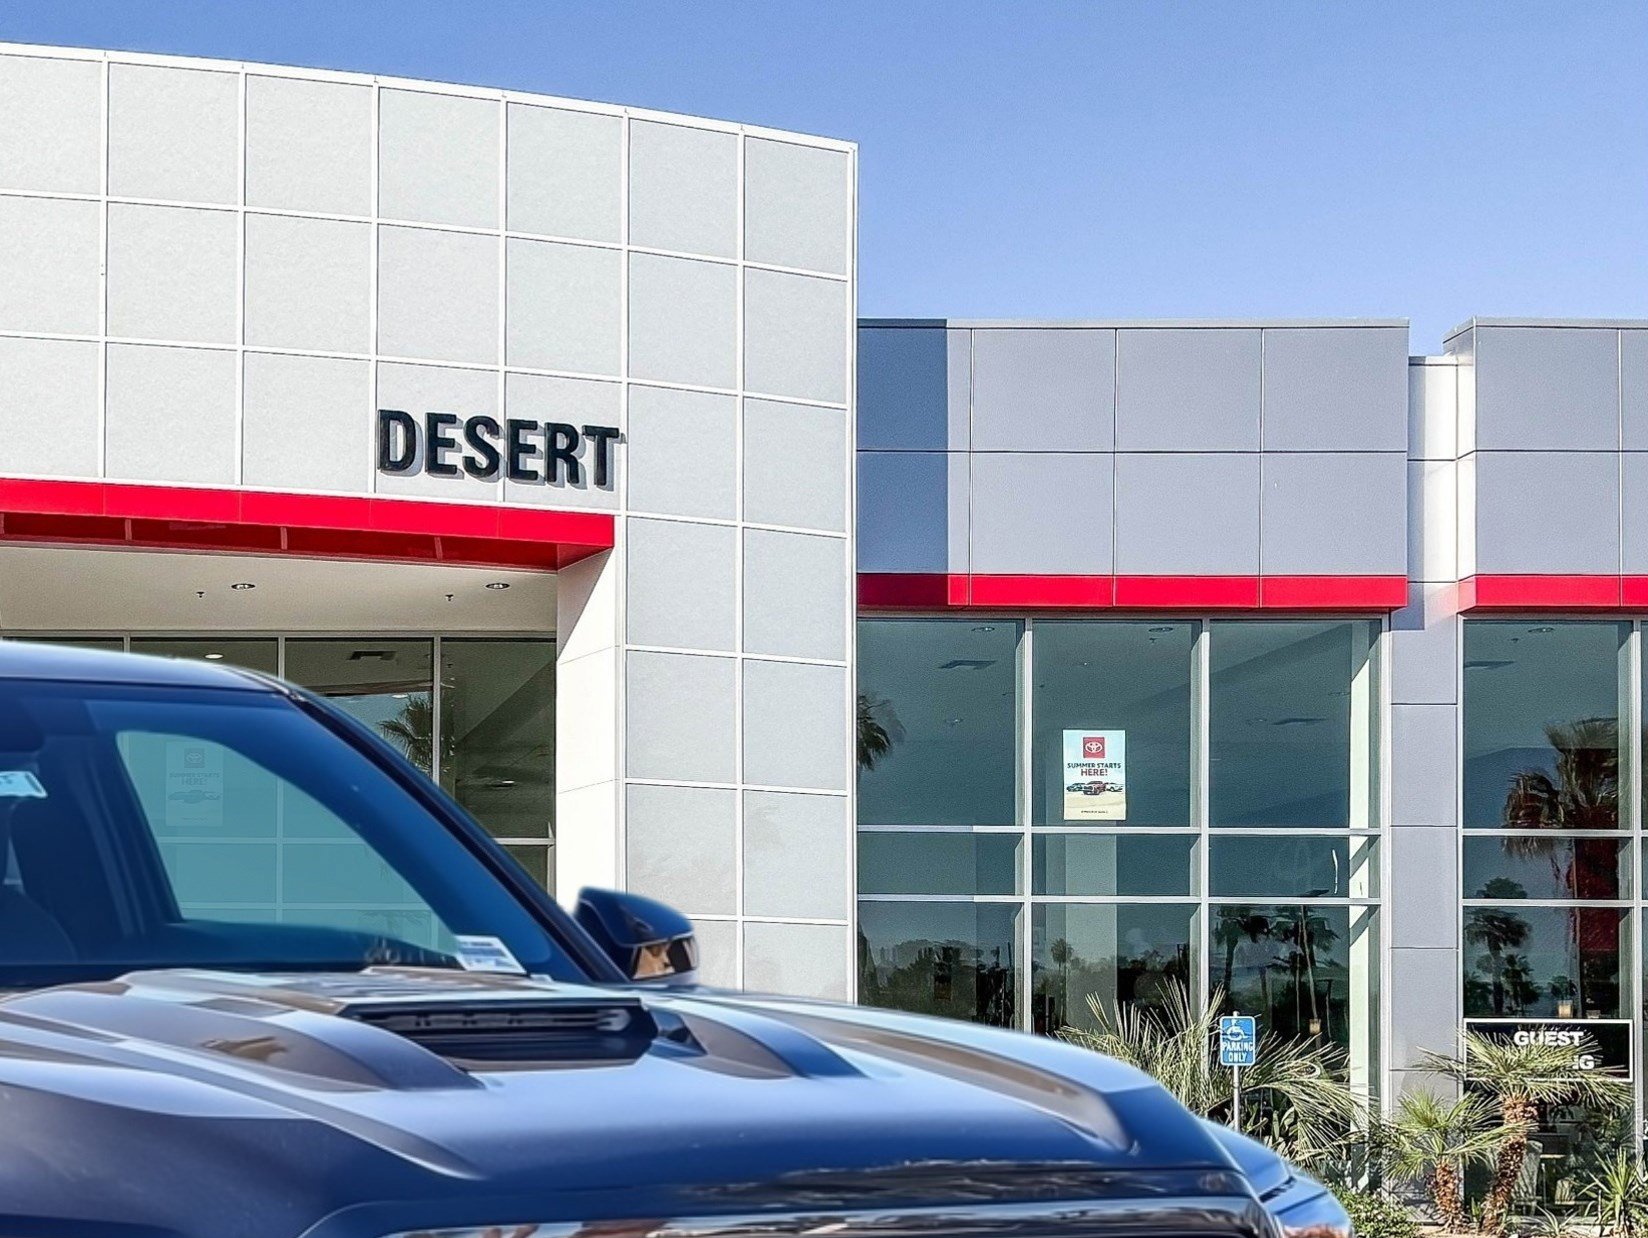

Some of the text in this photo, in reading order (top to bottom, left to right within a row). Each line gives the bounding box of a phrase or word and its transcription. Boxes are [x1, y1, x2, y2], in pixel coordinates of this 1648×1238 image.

[378, 409, 620, 486] DESERT
[1514, 1030, 1584, 1046] GUEST
[1222, 1041, 1253, 1051] PARKING
[1228, 1052, 1247, 1062] ONLY
